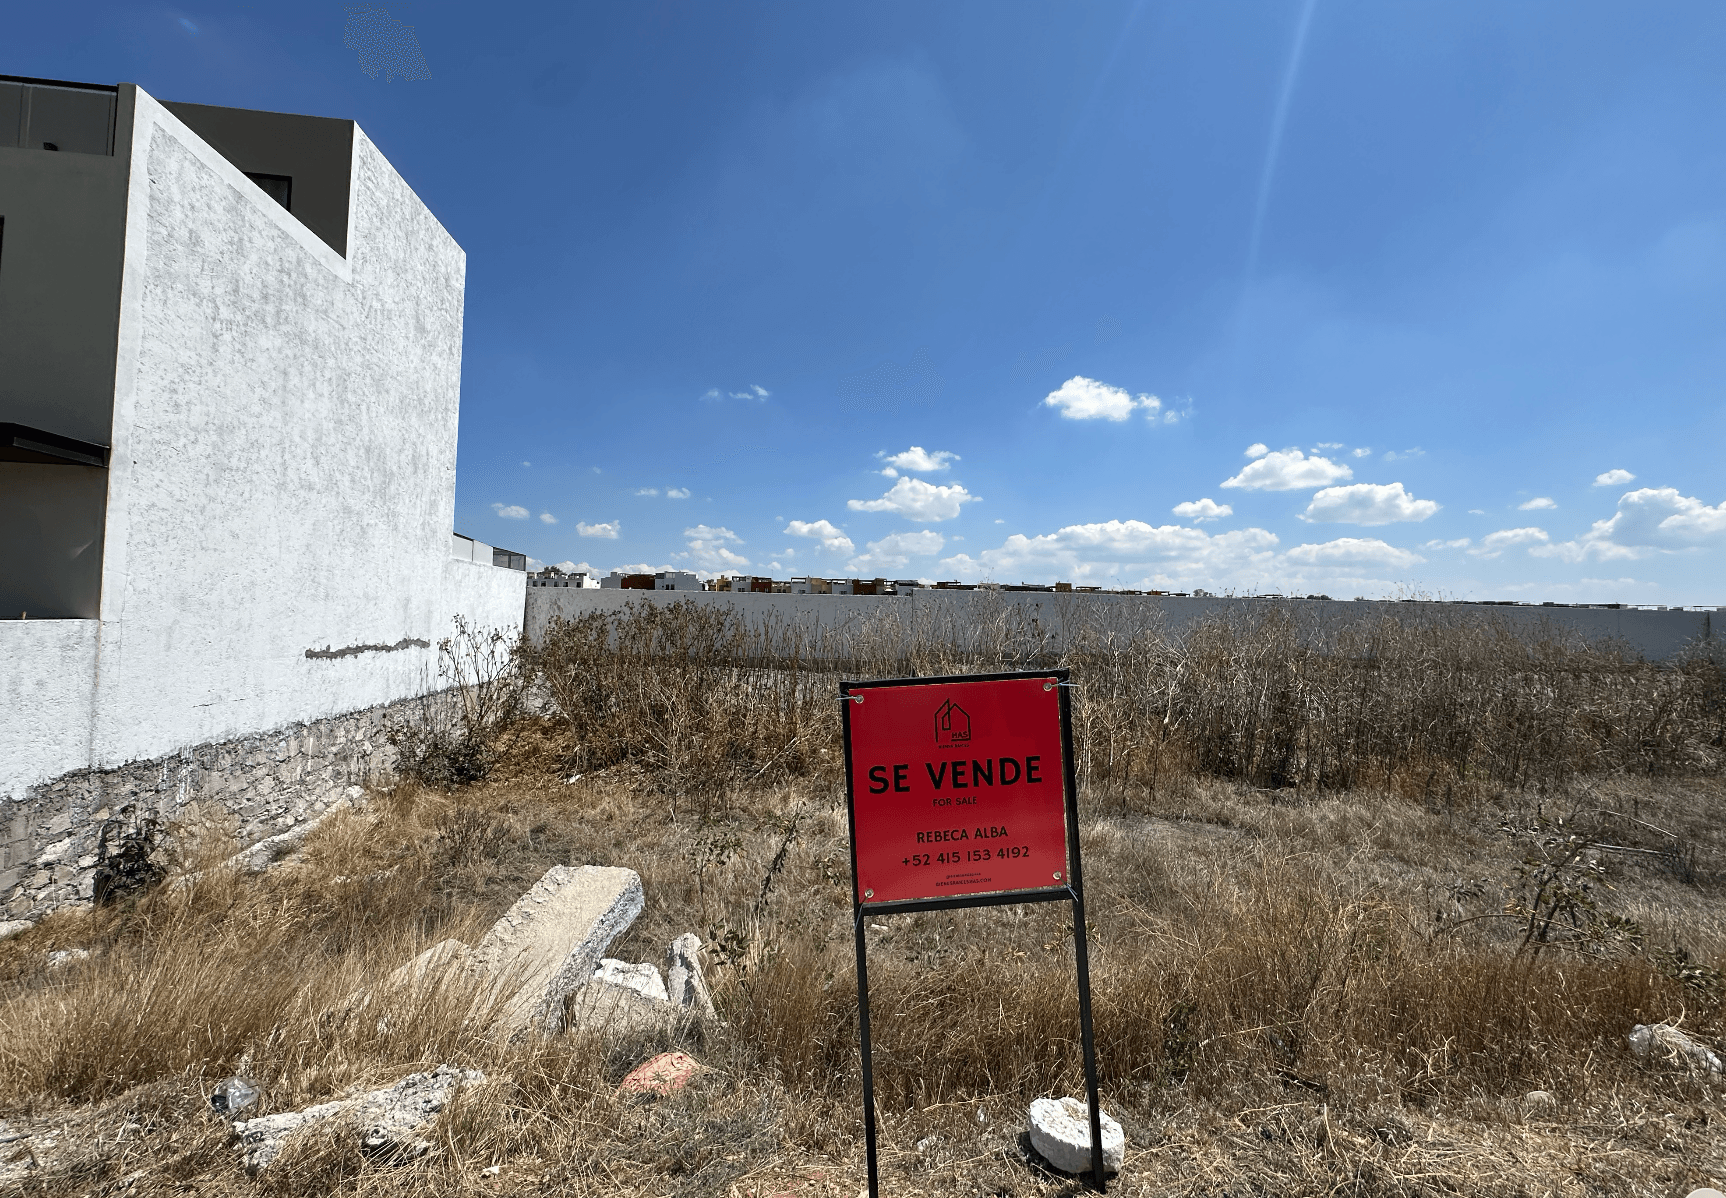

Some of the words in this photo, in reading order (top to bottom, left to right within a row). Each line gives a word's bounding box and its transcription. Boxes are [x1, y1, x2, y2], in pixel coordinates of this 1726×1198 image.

[868, 764, 910, 794] SE
[925, 755, 1042, 789] VENDE
[932, 797, 952, 807] FOR
[955, 796, 977, 805] SALE
[916, 829, 969, 843] REBECA
[974, 826, 1008, 839] ALBA
[902, 854, 931, 866] +52
[936, 852, 961, 864] 415
[967, 849, 991, 862] 153
[997, 846, 1030, 859] 4192
